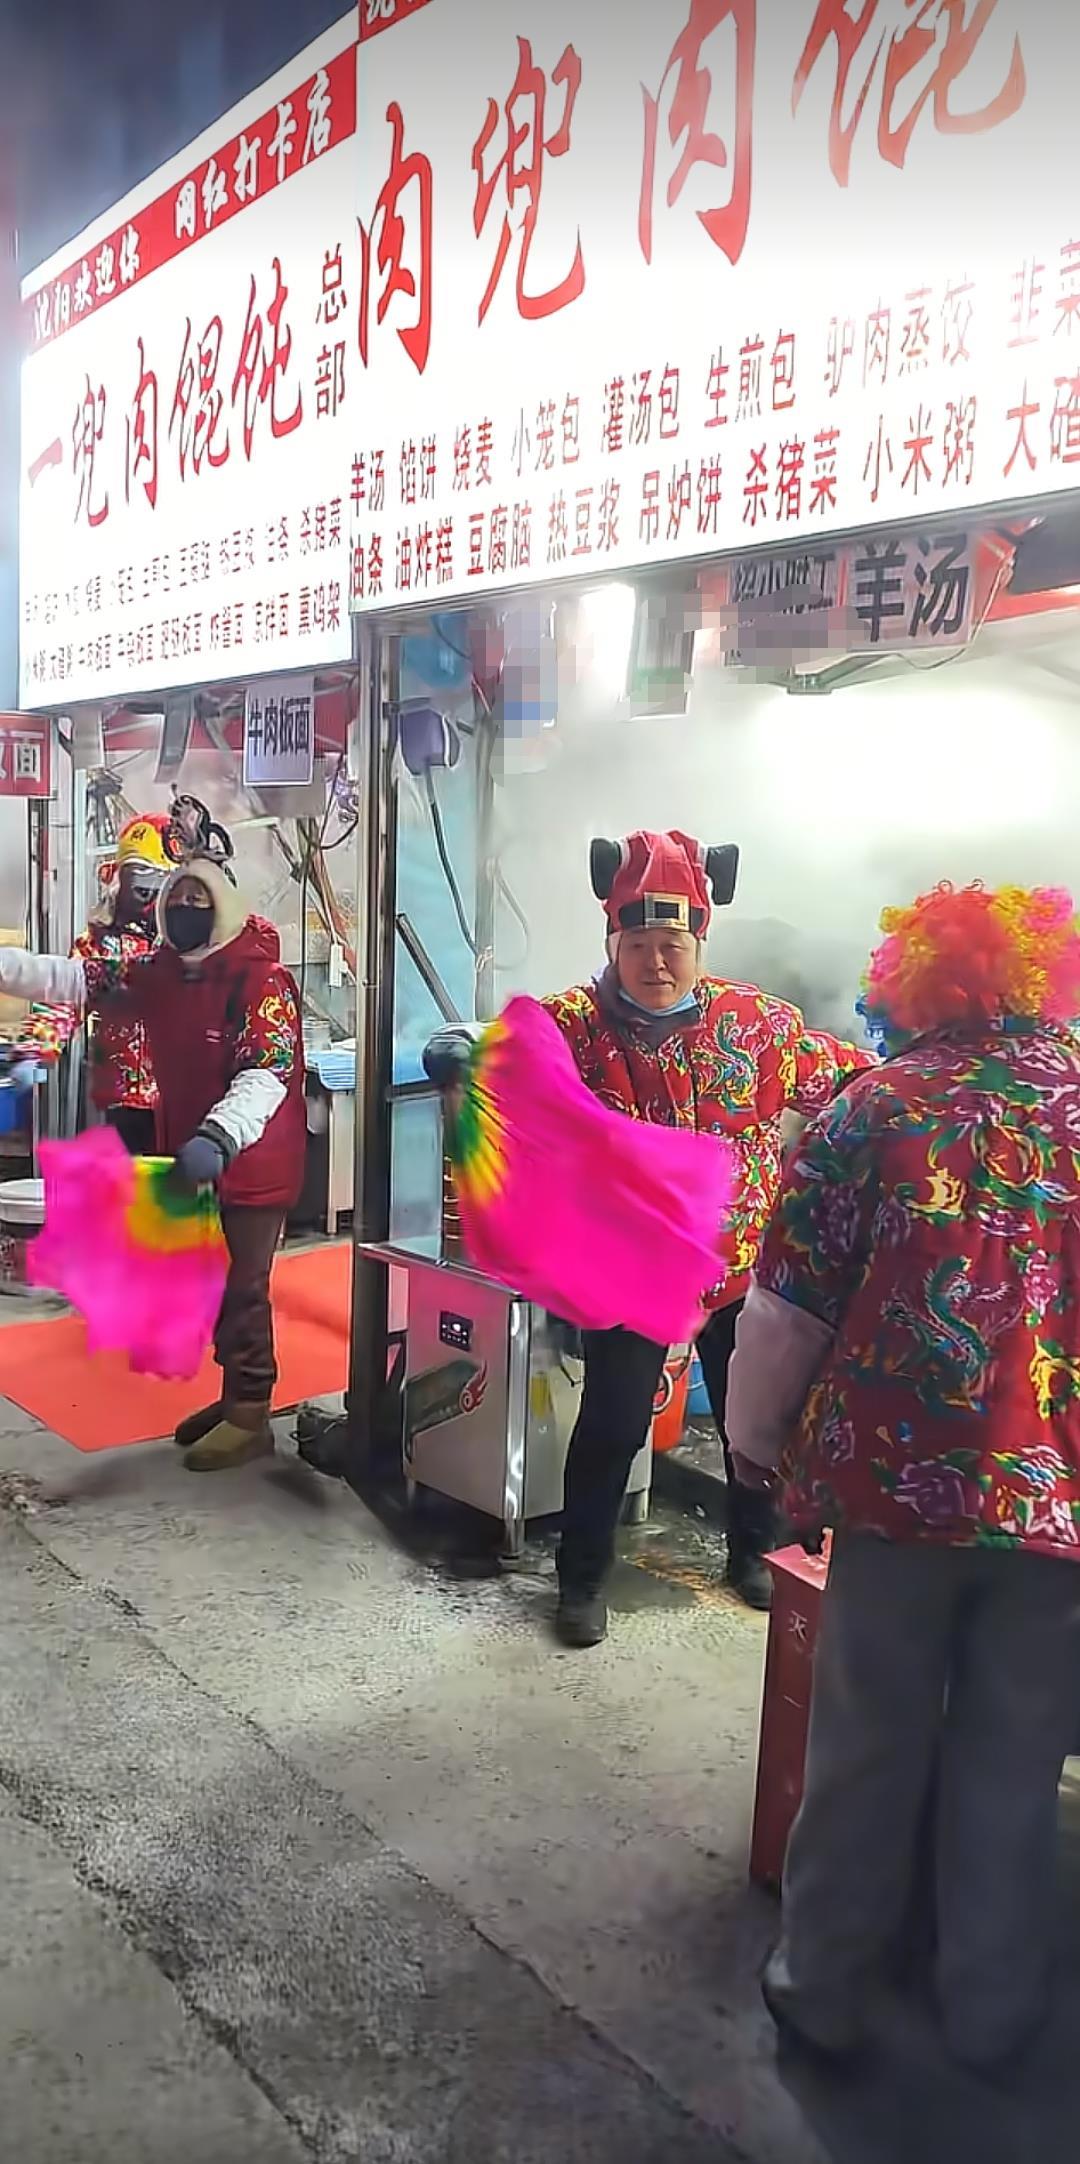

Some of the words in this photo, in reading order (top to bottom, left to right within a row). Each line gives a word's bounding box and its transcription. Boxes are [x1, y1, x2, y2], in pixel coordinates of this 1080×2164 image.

[175, 69, 332, 239] 网红打卡店
[28, 256, 303, 528] 一兜肉馄饨
[314, 243, 347, 420] 总部
[350, 450, 385, 517] 羊汤
[400, 434, 436, 505] 馅饼
[452, 416, 493, 491] 烧麦
[511, 392, 580, 477] 小笼包
[601, 362, 680, 454] 灌汤包
[704, 328, 796, 427] 生煎包
[823, 272, 976, 398] 驴肉蒸饺
[300, 497, 342, 556] 杀猪菜
[349, 532, 383, 600] 油条
[395, 516, 453, 592] 油炸糕
[466, 500, 532, 576] 豆腐脑
[547, 477, 620, 564] 热豆浆
[639, 453, 722, 545] 吊炉饼
[743, 425, 840, 527] 杀猪菜
[862, 394, 977, 503] 小米粥
[299, 579, 340, 637] 熏鸡架
[855, 534, 970, 643] 羊汤
[248, 695, 311, 758] 牛肉板面
